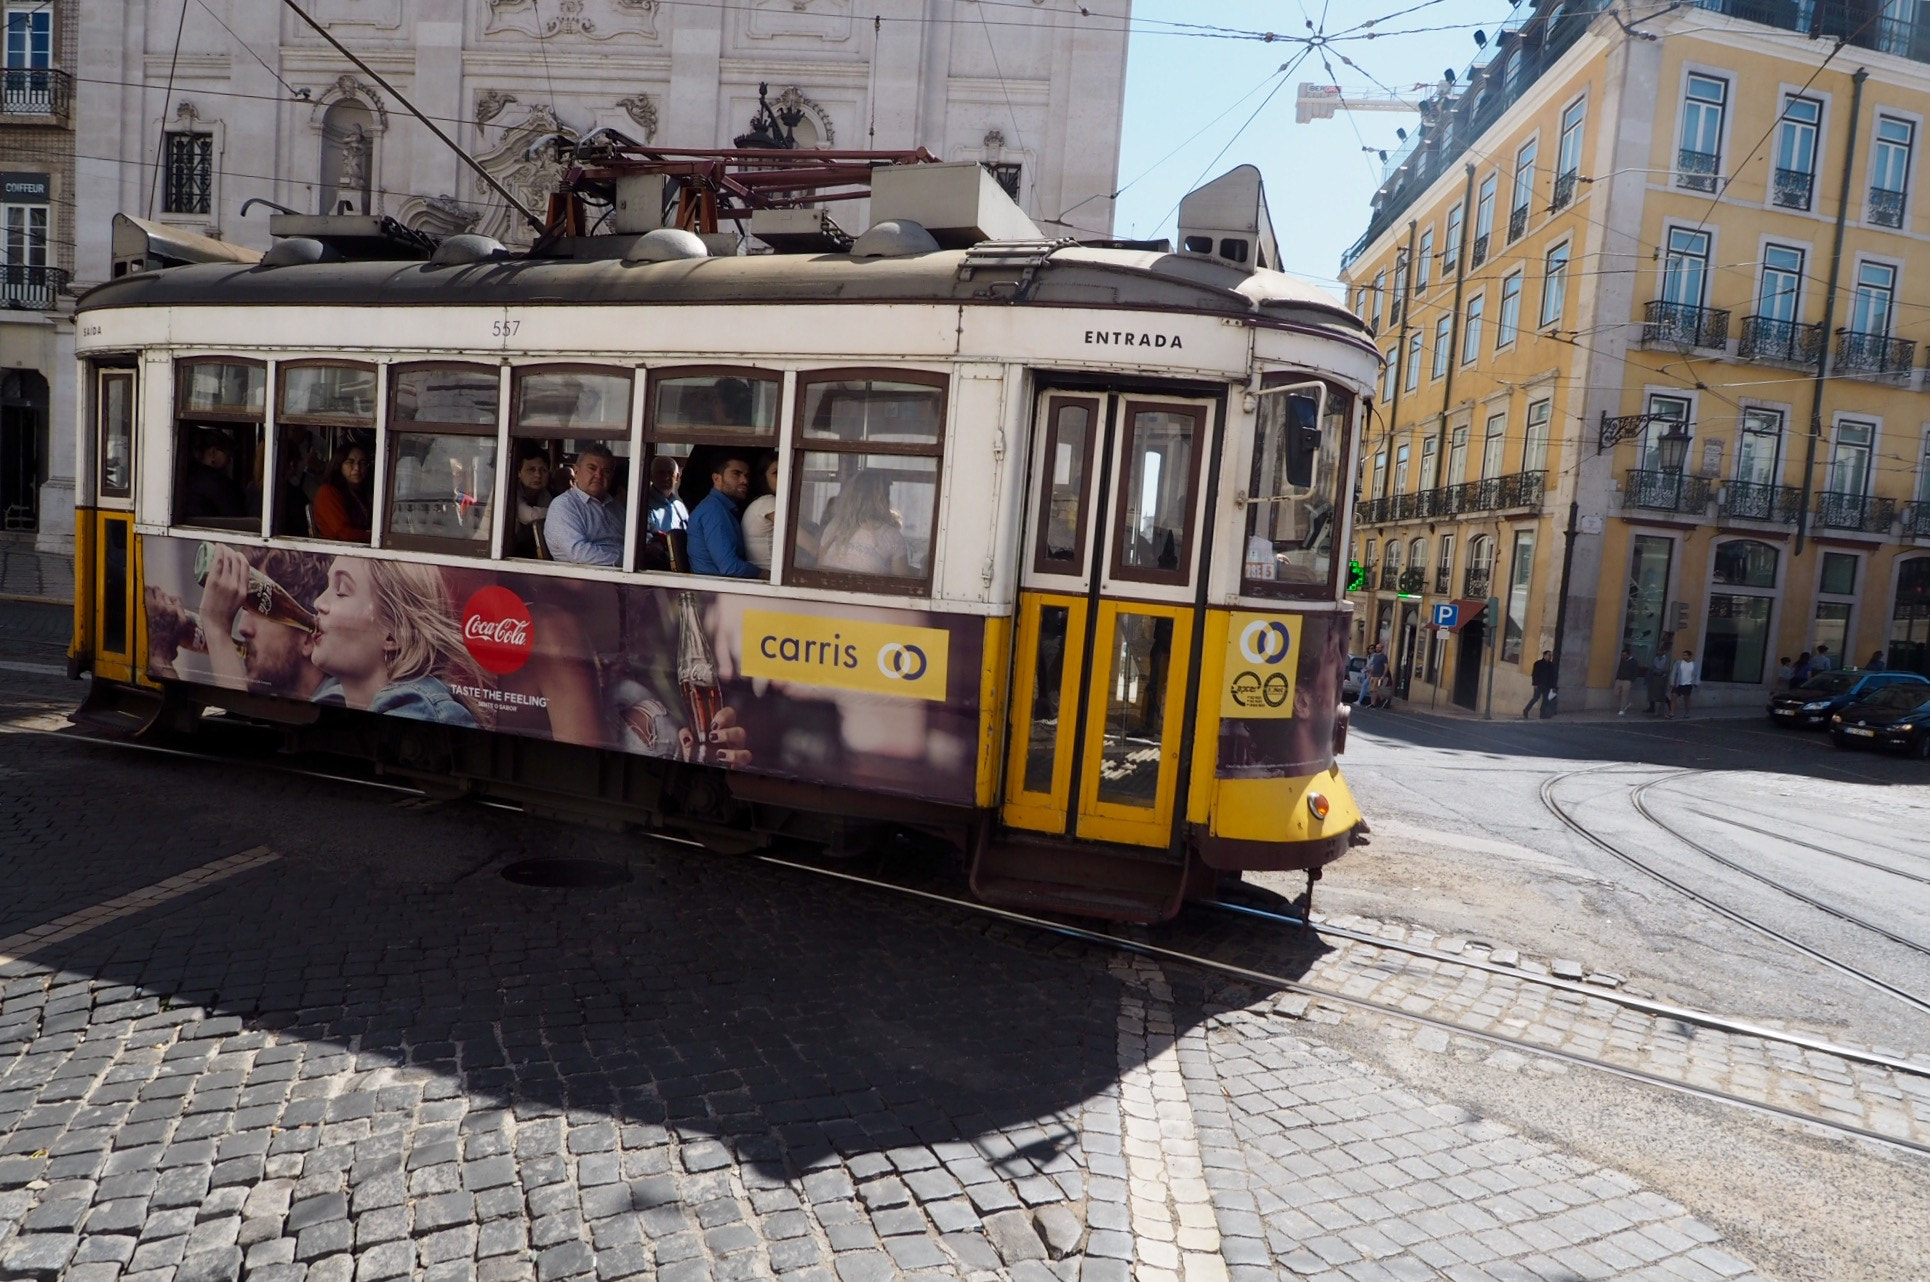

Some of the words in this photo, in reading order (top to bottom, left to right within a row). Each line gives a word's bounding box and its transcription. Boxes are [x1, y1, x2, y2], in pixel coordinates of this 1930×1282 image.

[5, 183, 44, 193] COIFFEUR
[492, 320, 520, 337] 557
[1085, 331, 1182, 348] ENTRADA
[1438, 606, 1453, 624] P
[465, 614, 530, 646] Coca-Cola
[760, 633, 858, 669] carris
[450, 684, 480, 698] TASTE
[483, 688, 502, 701] THE
[504, 692, 547, 708] FEELING
